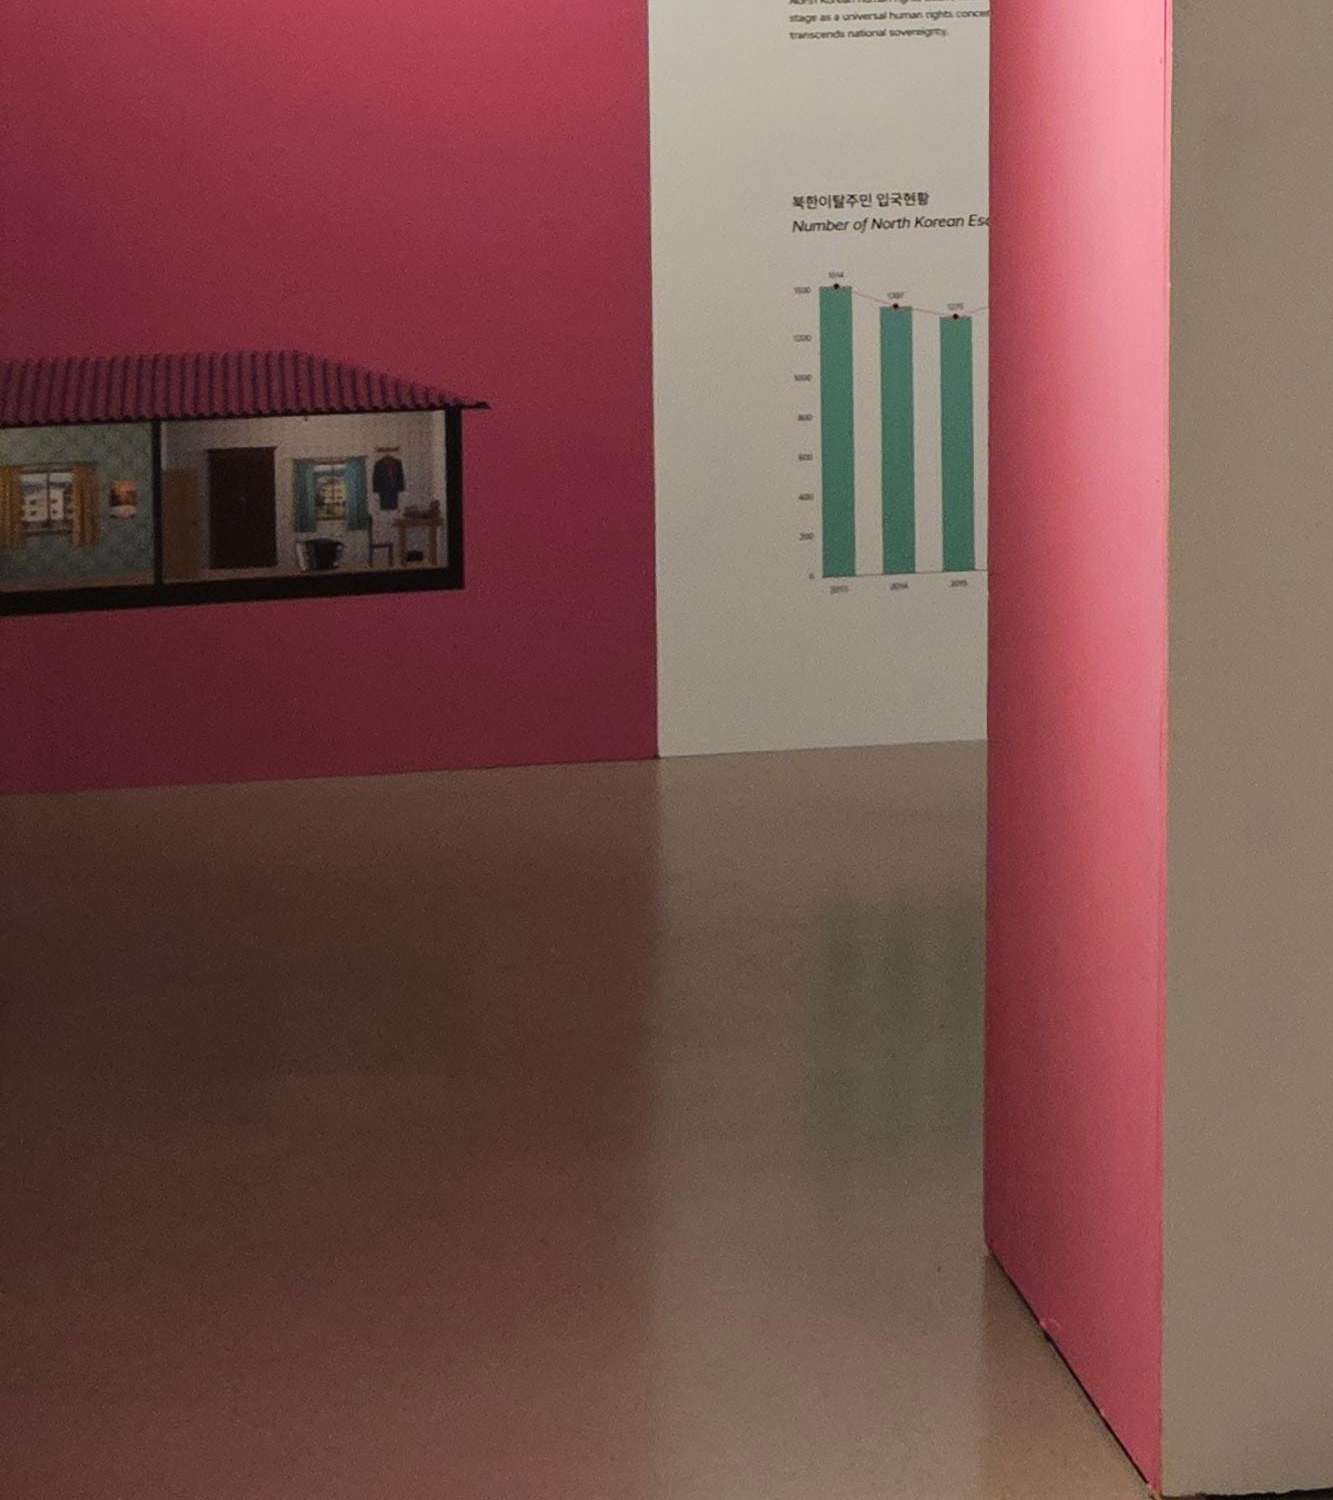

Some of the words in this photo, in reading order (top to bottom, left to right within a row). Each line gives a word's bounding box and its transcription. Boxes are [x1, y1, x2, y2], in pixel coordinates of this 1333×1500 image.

[792, 194, 873, 209] 북한이탈주민
[876, 191, 930, 207] 입국현황
[792, 219, 850, 232] Number
[852, 217, 868, 233] of
[871, 217, 911, 230] North
[913, 215, 965, 228] Korean
